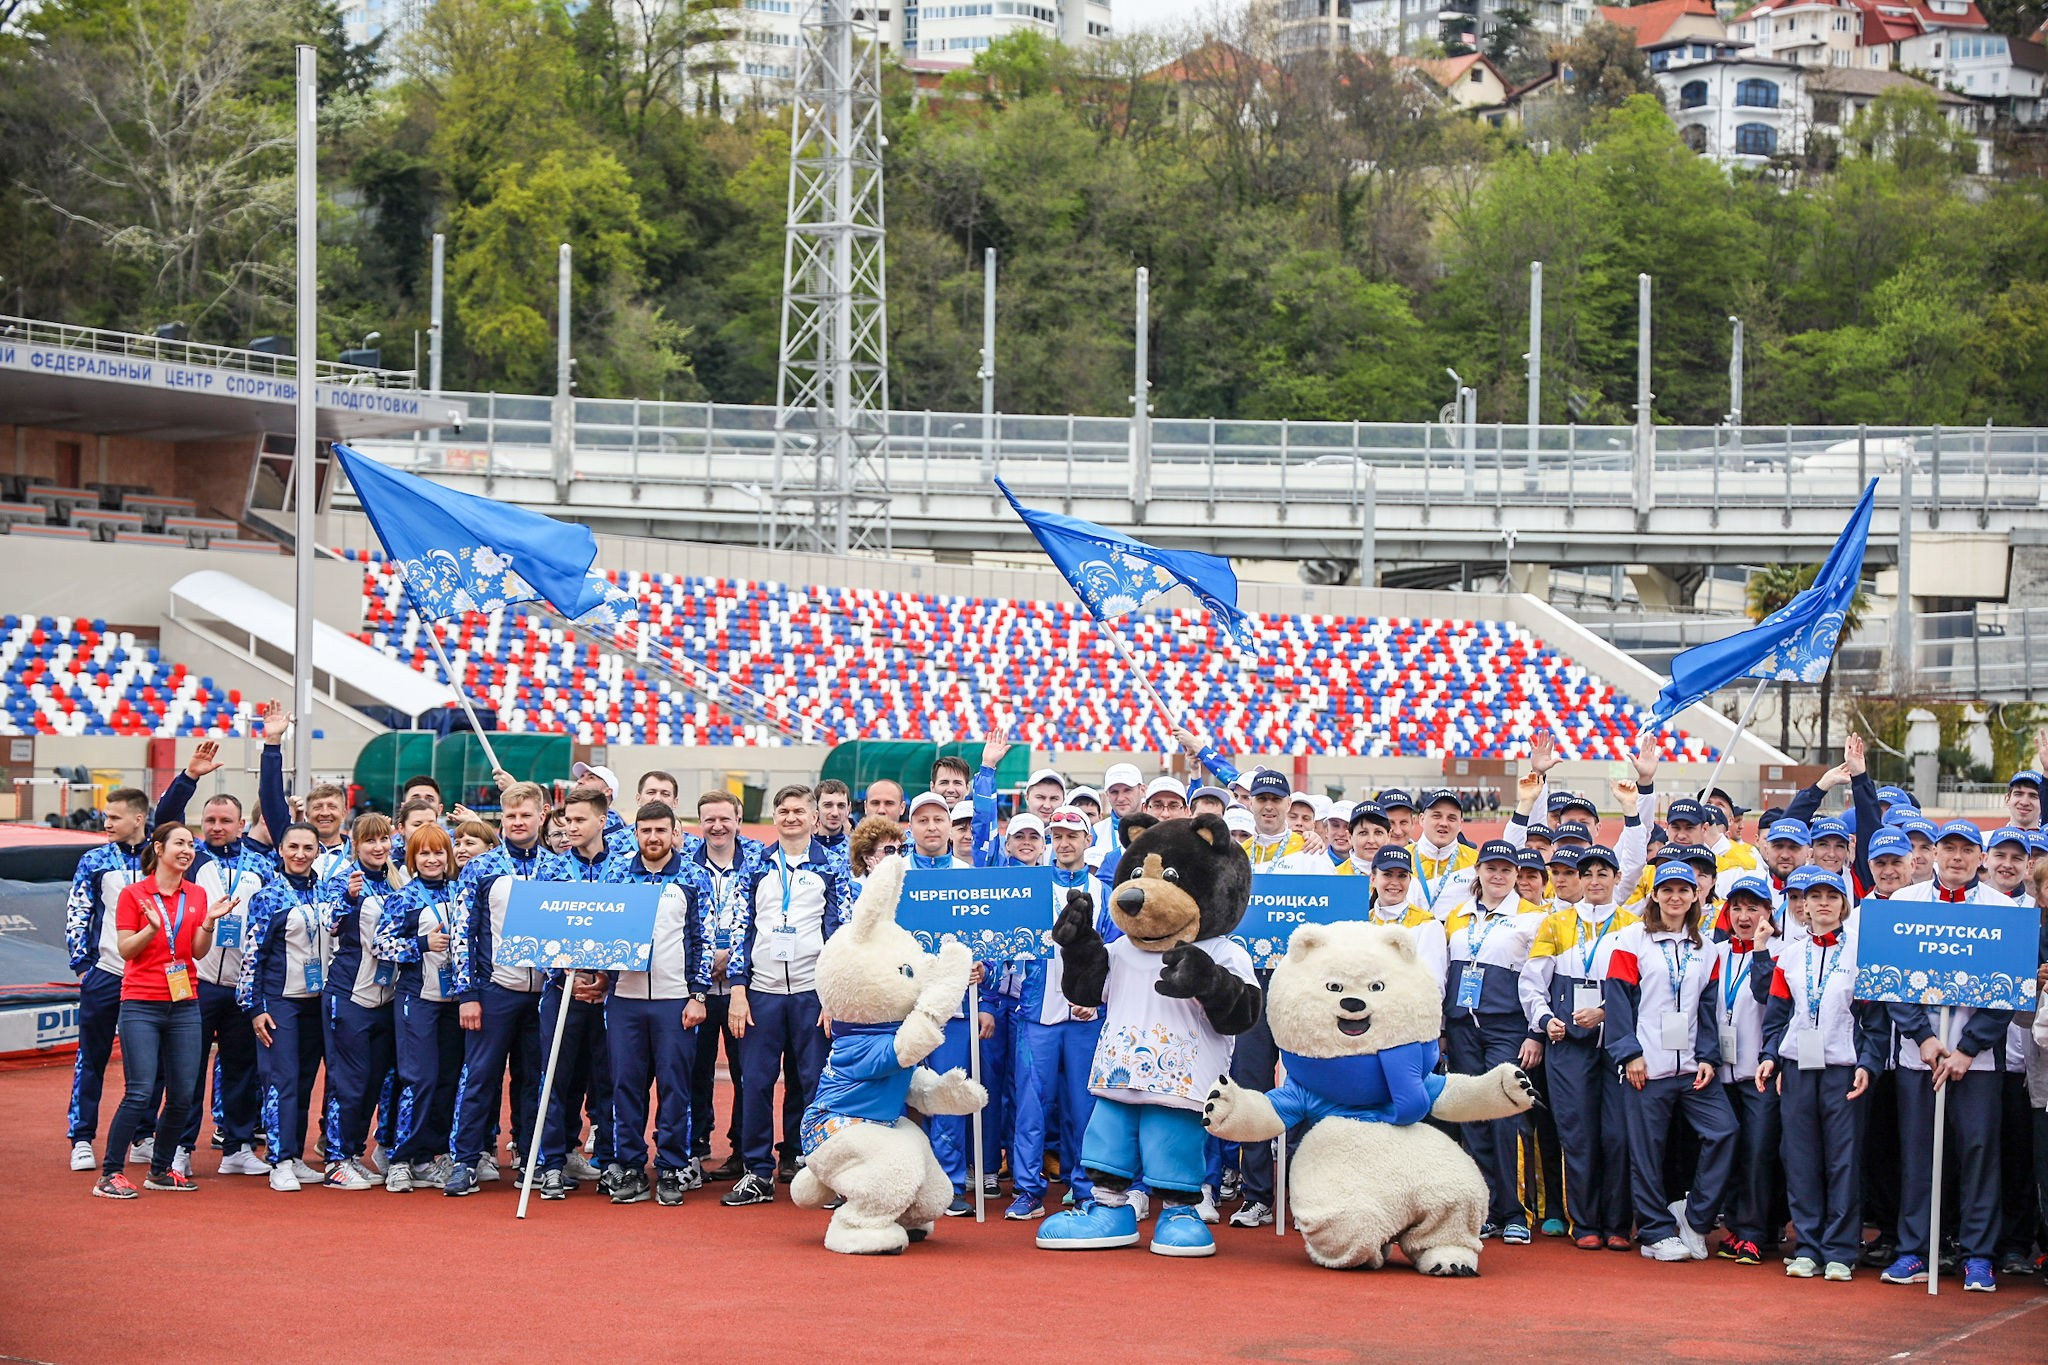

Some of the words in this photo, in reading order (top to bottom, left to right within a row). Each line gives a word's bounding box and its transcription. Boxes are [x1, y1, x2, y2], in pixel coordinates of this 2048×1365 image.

[31, 352, 152, 380] ФЕДЕРАЛЬНЫЙ
[165, 368, 213, 388] ЦЕНТР
[331, 391, 419, 414] ПОДГОТОВКИ
[909, 887, 1032, 901] ЧЕРЕПОВЕЦКАЯ
[539, 900, 626, 913] АДЛЕРСКАЯ
[952, 904, 990, 916] ГРЭС
[566, 915, 593, 926] ТЭС
[1267, 911, 1306, 922] ГРЭС
[1893, 922, 2002, 940] СУРГУТСКАЯ
[1918, 942, 1973, 956] ГРЭС-1
